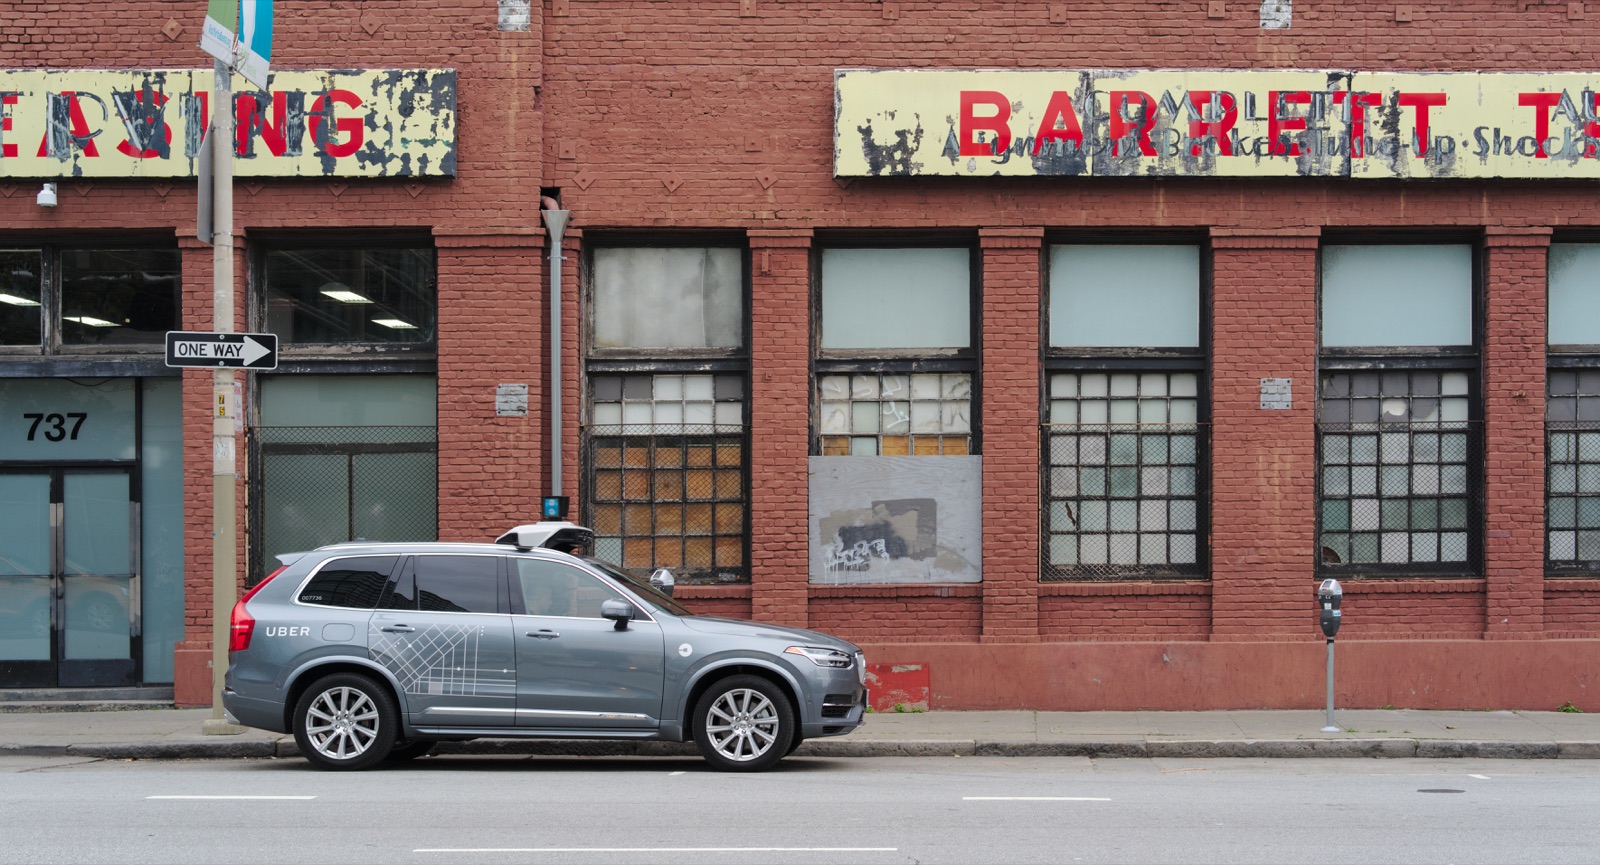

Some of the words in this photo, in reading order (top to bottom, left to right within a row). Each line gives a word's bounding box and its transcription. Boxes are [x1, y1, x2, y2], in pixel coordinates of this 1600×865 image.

[960, 90, 1446, 158] BARRETT
[178, 343, 208, 356] ONE
[213, 344, 243, 357] WAY
[23, 412, 88, 442] 737
[265, 626, 310, 637] UBER
